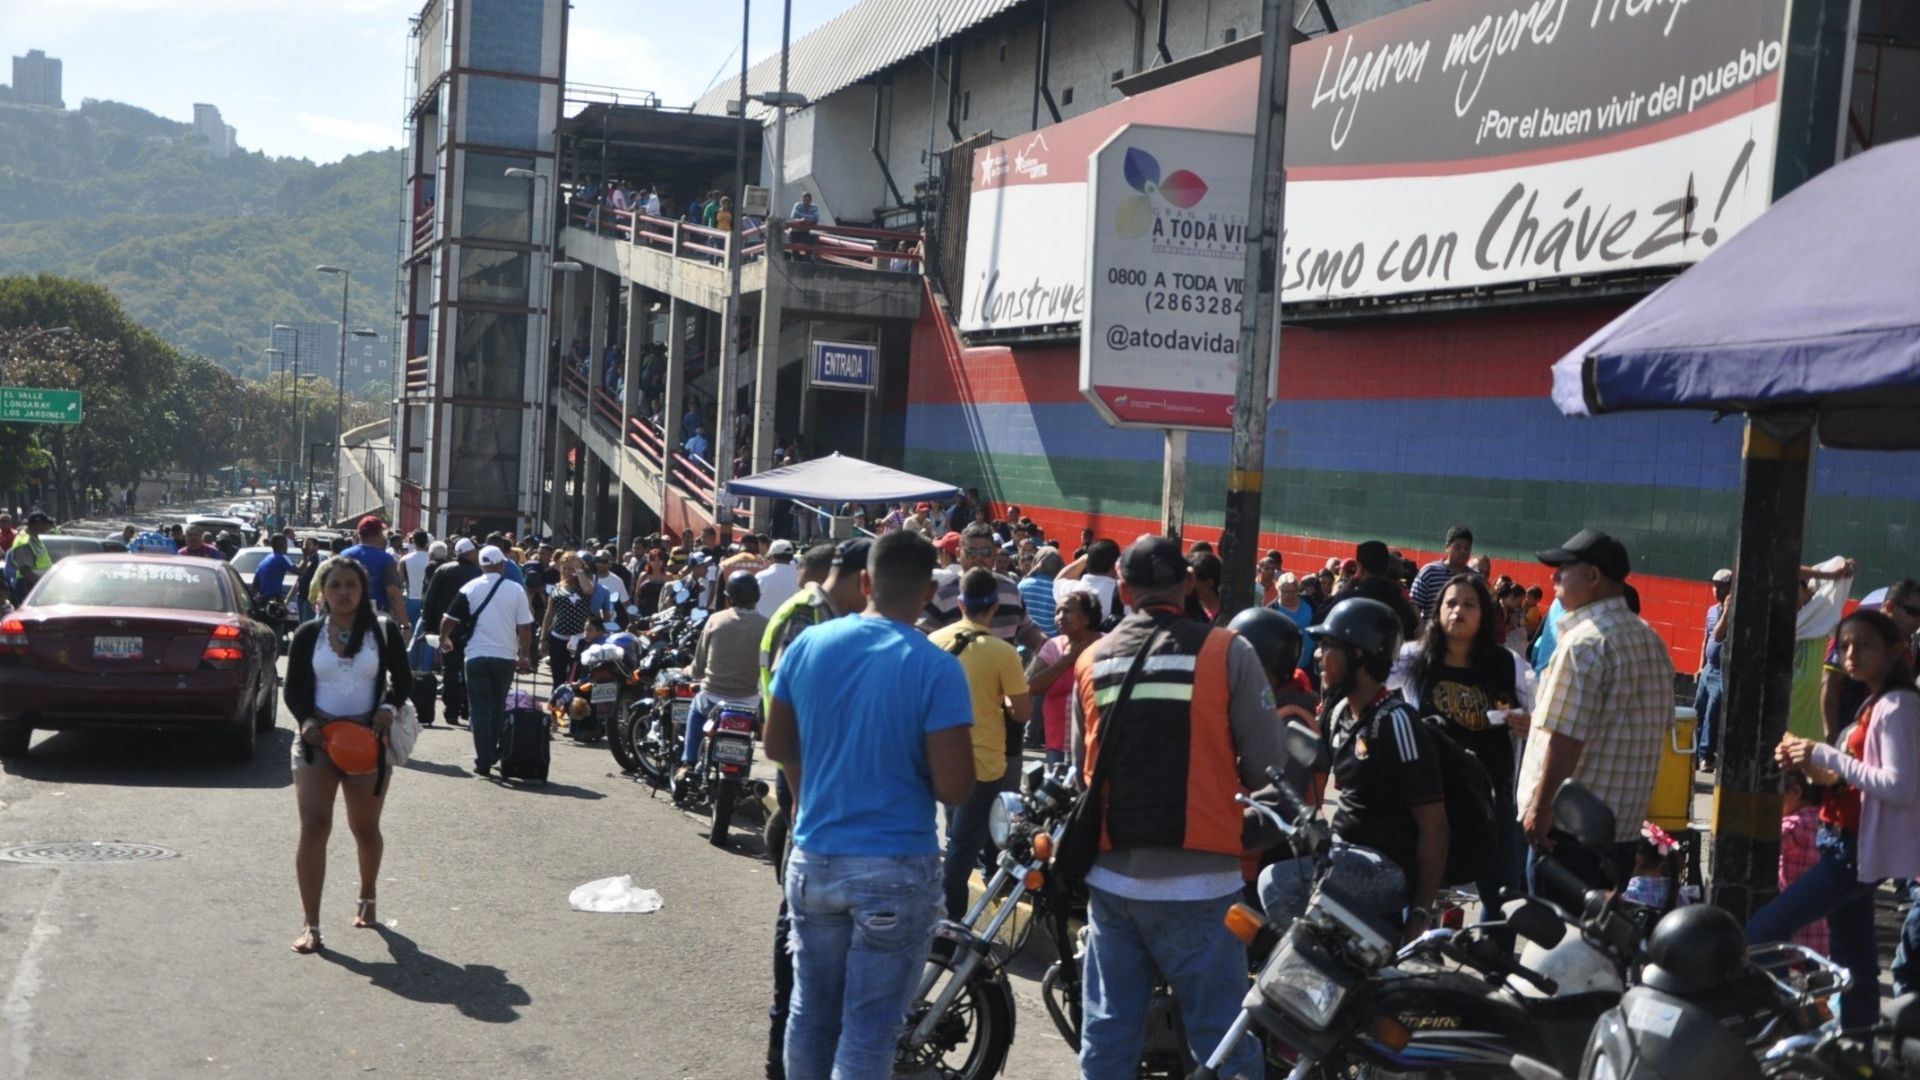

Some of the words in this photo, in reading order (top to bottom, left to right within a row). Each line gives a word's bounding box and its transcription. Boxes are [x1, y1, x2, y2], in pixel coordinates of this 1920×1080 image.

[1311, 34, 1431, 151] Llegaron
[1441, 0, 1568, 118] mejores
[1518, 108, 1540, 139] el
[1540, 107, 1592, 138] buen
[1597, 91, 1645, 131] vivir
[1647, 75, 1686, 119] del
[1687, 39, 1783, 113] pueblo
[1152, 216, 1165, 238] A
[1170, 218, 1218, 242] TODA
[1224, 223, 1248, 245] VI
[1281, 228, 1365, 298] ismo
[1376, 231, 1458, 283] con
[1108, 267, 1147, 287] 0800
[1153, 271, 1167, 289] A
[1172, 273, 1218, 293] TODA
[824, 351, 864, 378] ENTRADA
[4, 391, 14, 399] EL
[18, 391, 44, 400] VALLE
[4, 400, 51, 410] LONGARAY
[4, 409, 20, 418] LOS
[24, 411, 66, 420] JARDINES
